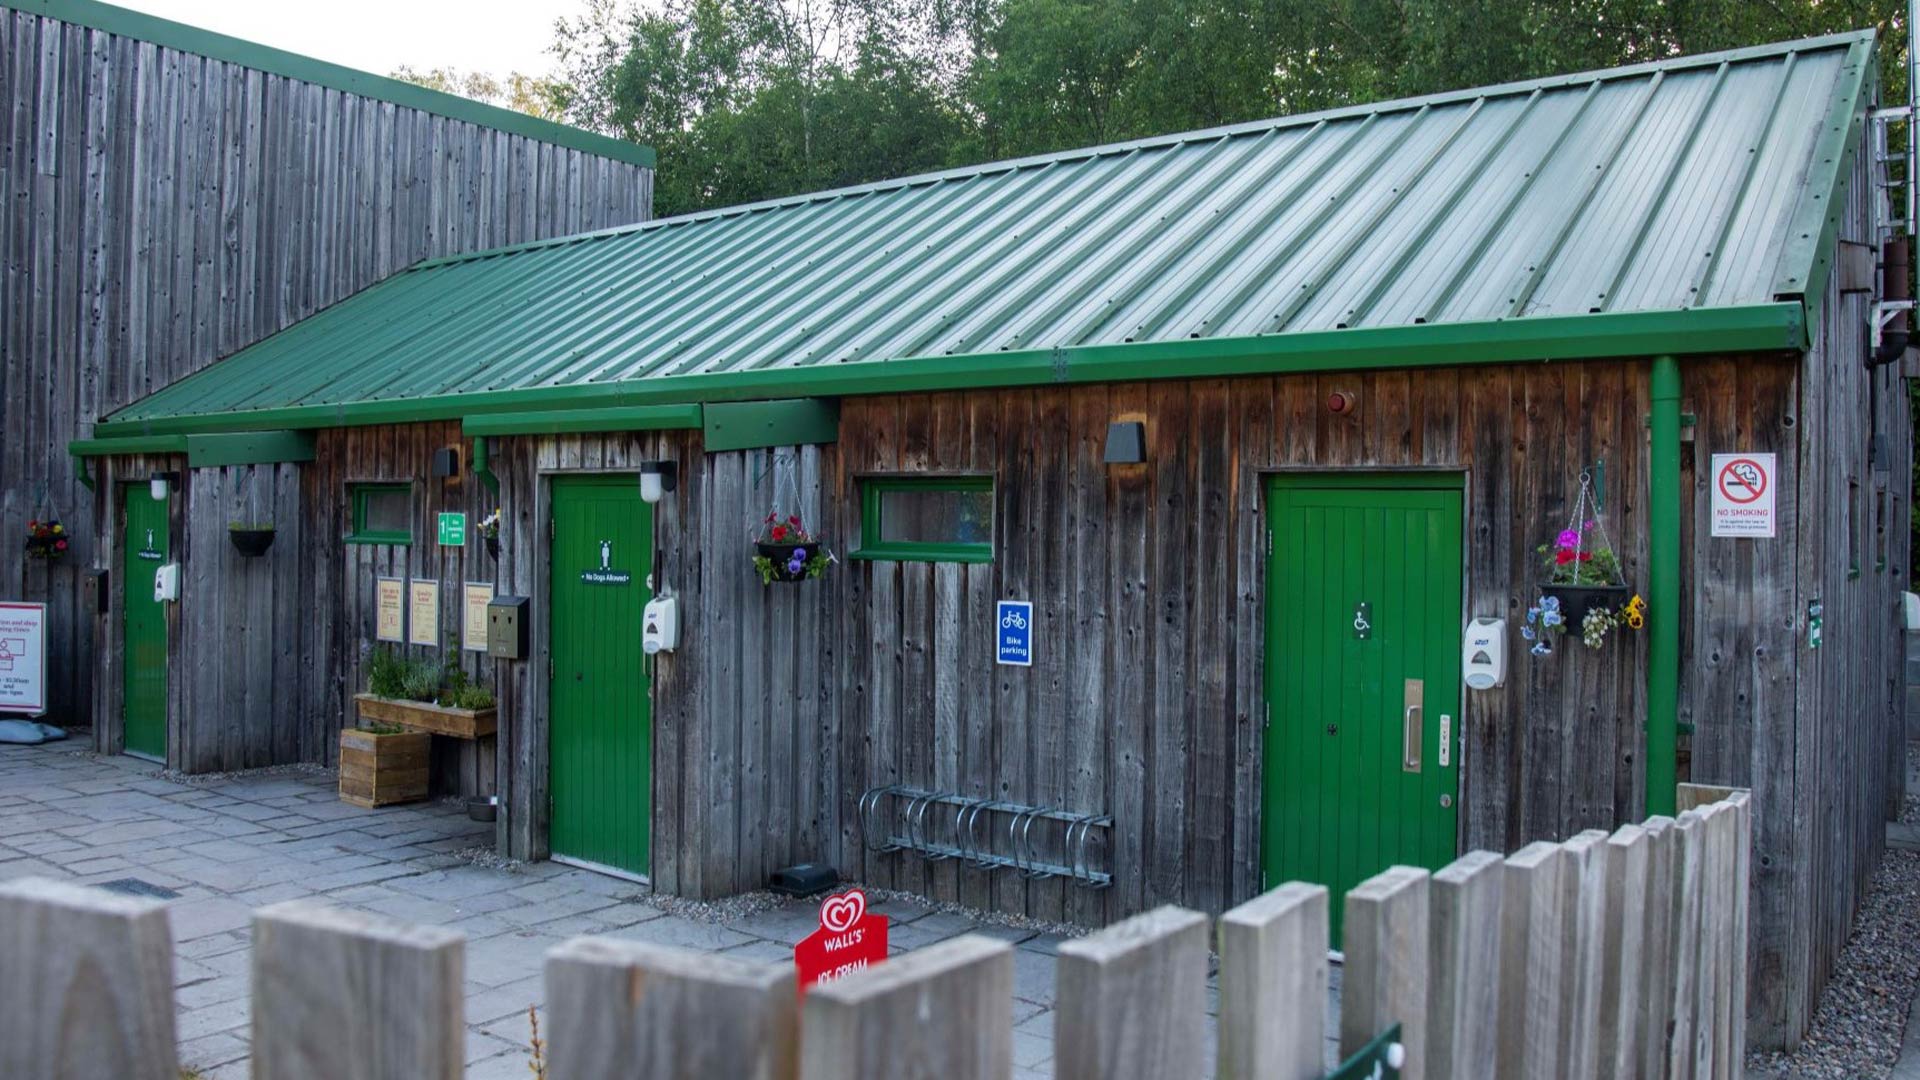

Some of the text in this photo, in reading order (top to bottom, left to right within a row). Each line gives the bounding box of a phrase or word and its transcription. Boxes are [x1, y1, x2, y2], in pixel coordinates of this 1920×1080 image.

[1717, 509, 1768, 517] NO SMOKING
[440, 519, 445, 535] 1
[586, 573, 627, 582] No Dogs Allowed
[1001, 636, 1027, 656] Bike parking
[824, 928, 863, 953] WALL'S
[835, 956, 868, 982] CREAM
